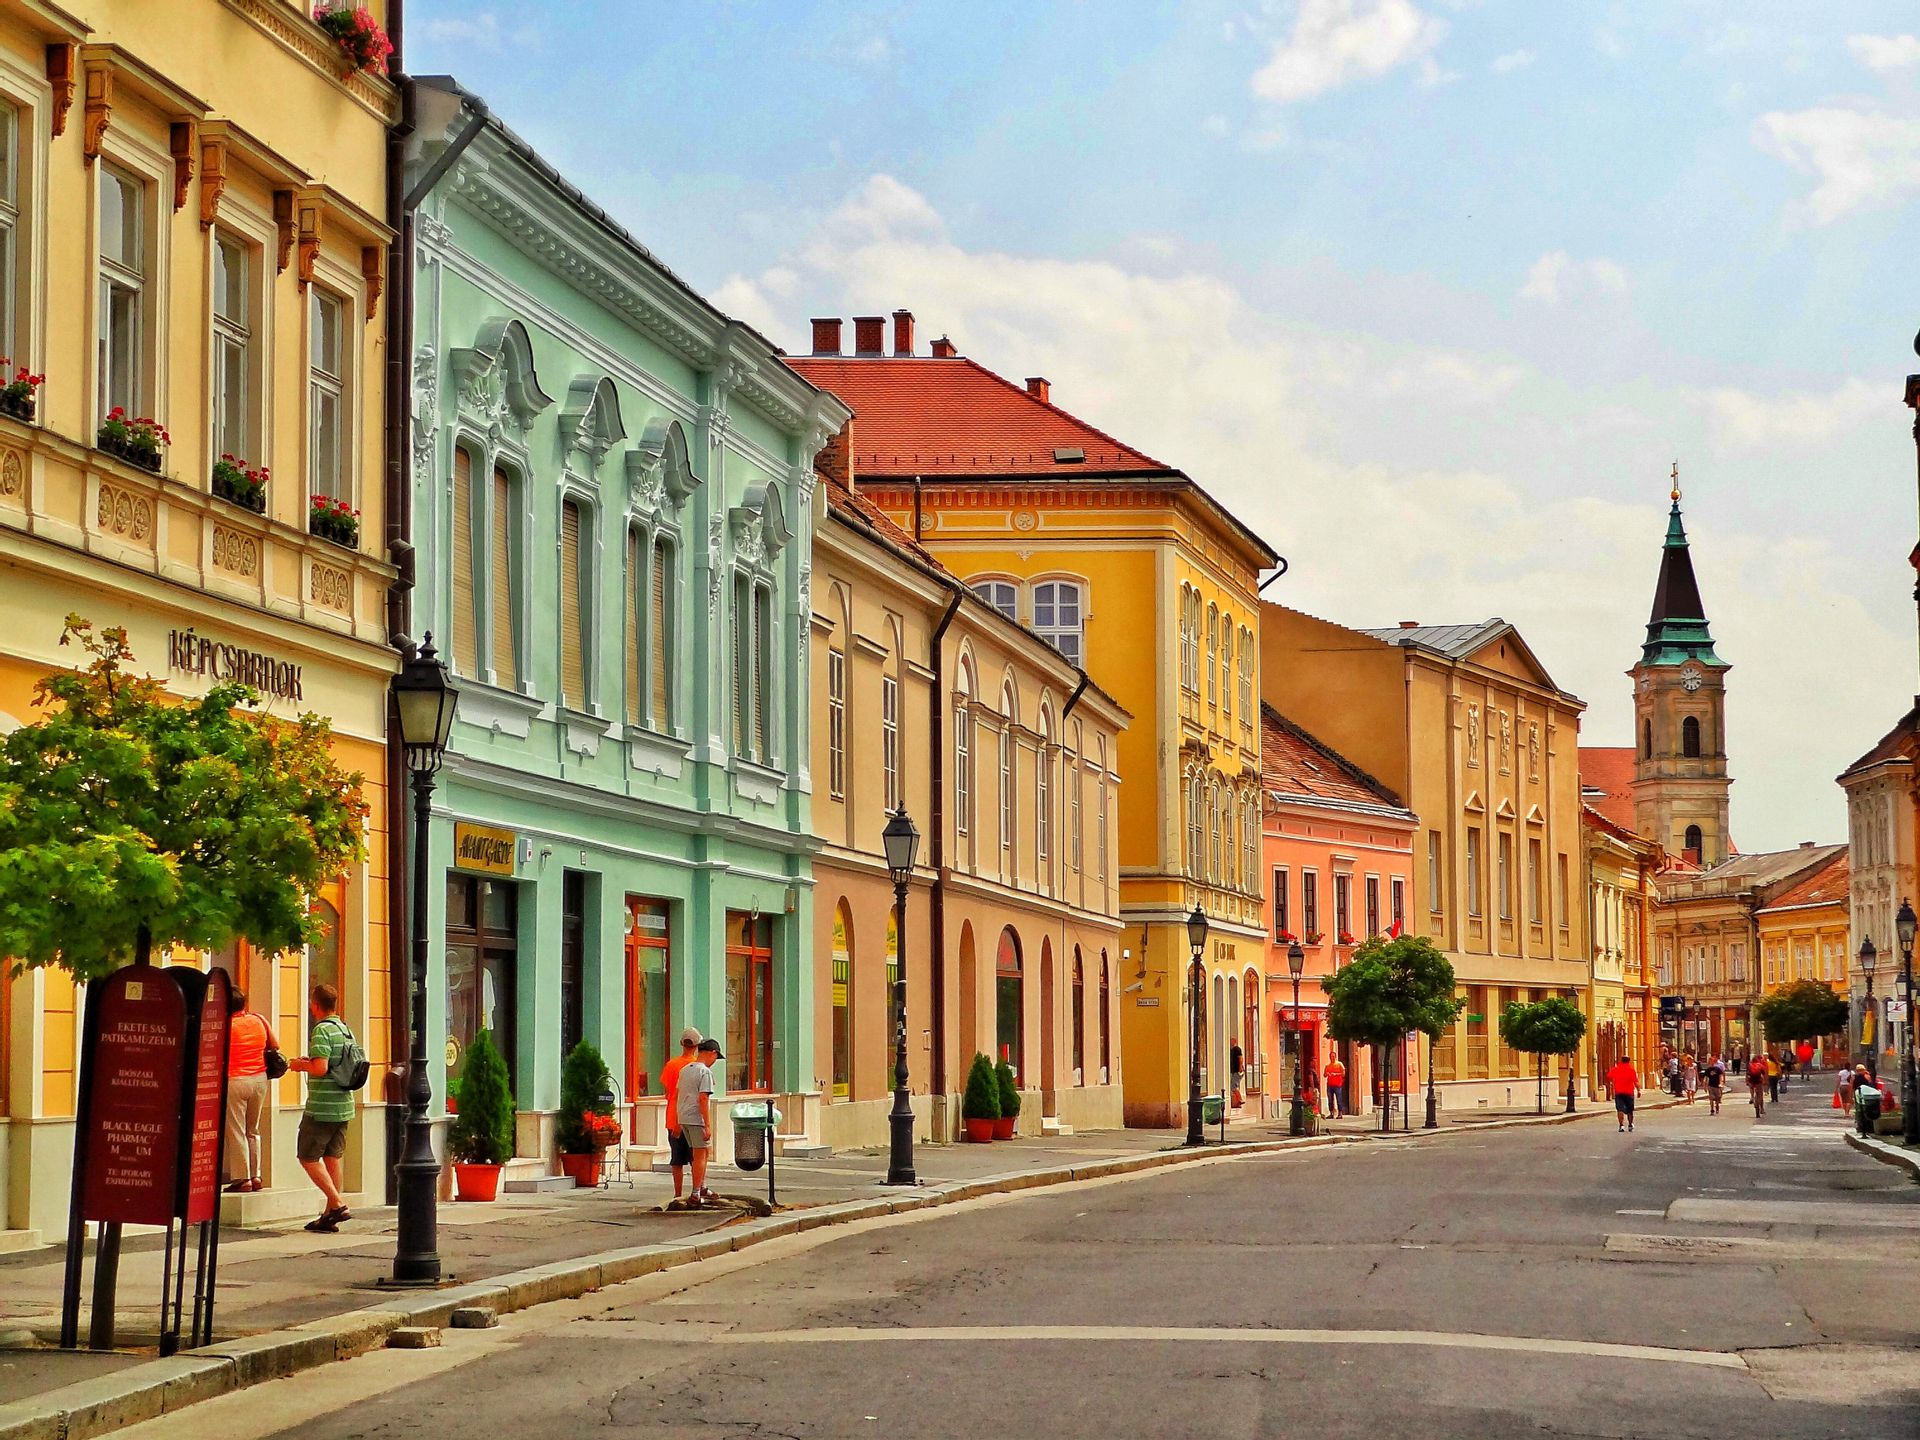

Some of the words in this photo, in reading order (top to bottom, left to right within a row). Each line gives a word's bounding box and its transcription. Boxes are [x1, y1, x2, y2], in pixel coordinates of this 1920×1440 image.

[169, 627, 303, 701] KÉPCSARNOK
[150, 1024, 167, 1034] SAS
[102, 1120, 131, 1132] BLACK
[134, 1122, 163, 1134] EAGLE
